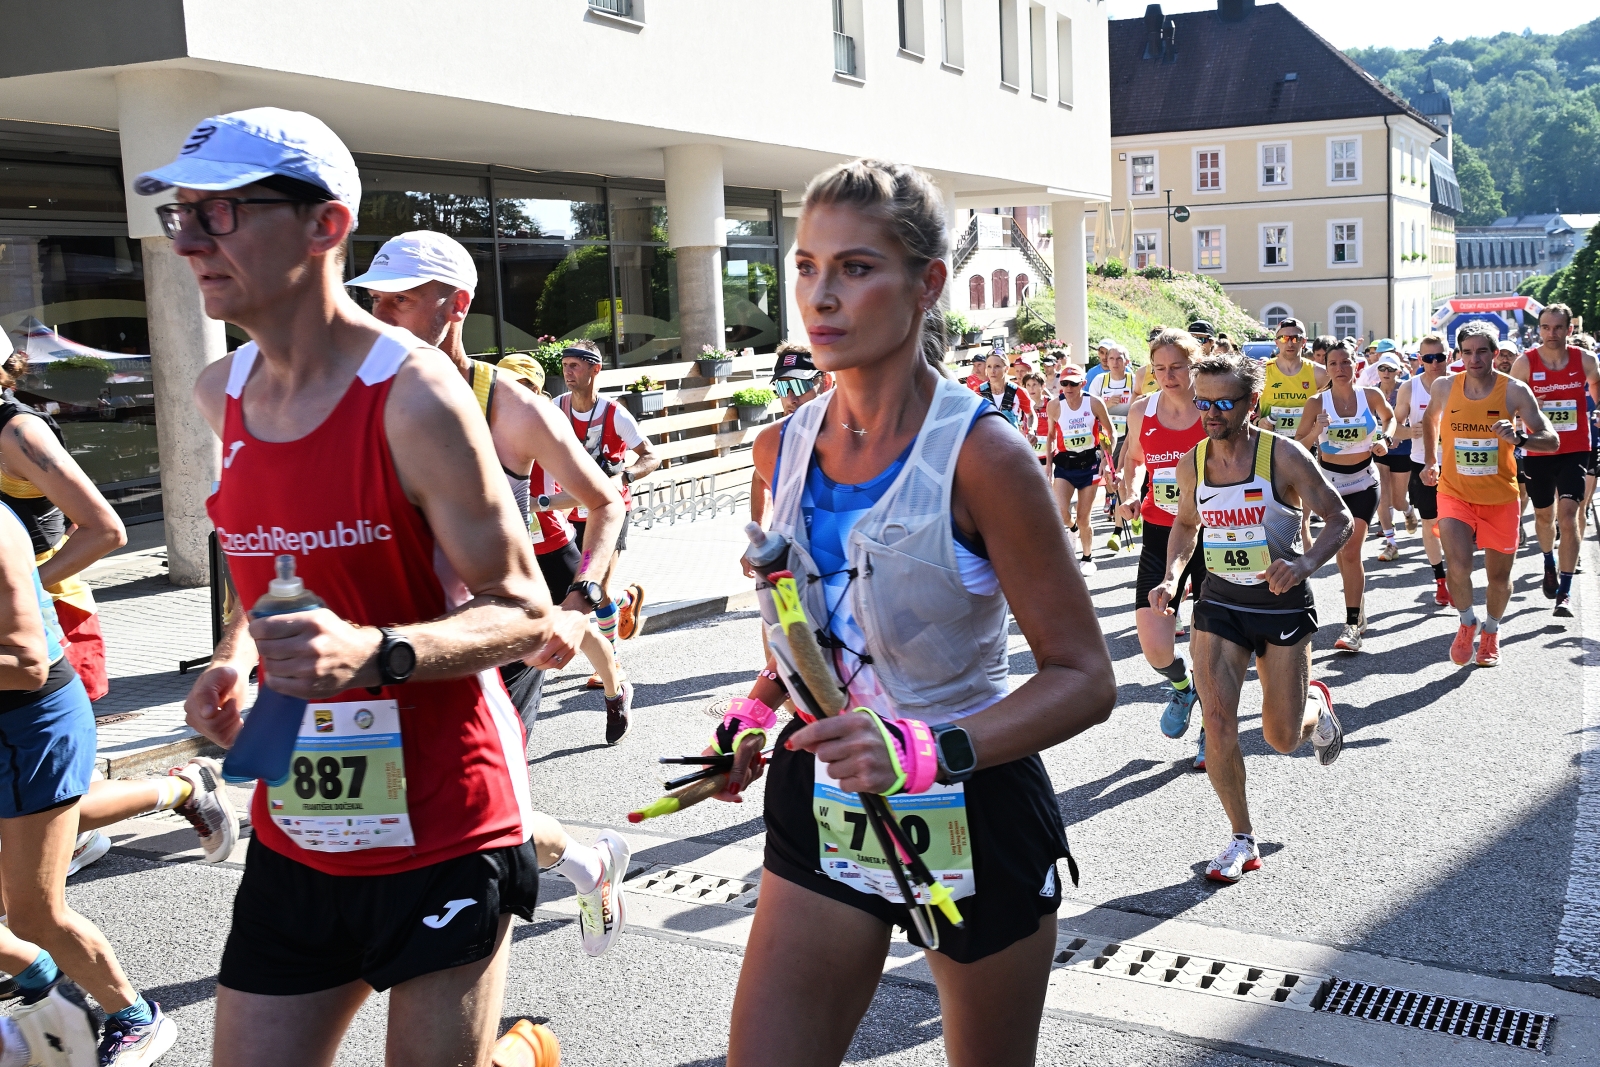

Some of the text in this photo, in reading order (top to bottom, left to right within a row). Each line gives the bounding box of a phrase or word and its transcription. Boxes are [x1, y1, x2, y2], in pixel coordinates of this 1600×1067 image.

[1533, 381, 1582, 393] CzechRepublic
[1273, 392, 1308, 400] LIETUVA
[1281, 417, 1294, 427] 78
[1548, 411, 1569, 421] 733
[1336, 428, 1359, 439] 424
[1450, 422, 1493, 433] GERMAN
[1071, 437, 1086, 446] 179
[1463, 451, 1488, 463] 133
[1202, 505, 1267, 527] GERMANY
[216, 519, 393, 556] CzechRepublic
[1224, 549, 1250, 567] 48
[293, 755, 368, 800] 887
[819, 805, 829, 817] W
[844, 810, 931, 856] 70
[857, 853, 882, 865] ŽANETA
[602, 879, 613, 934] TERREX
